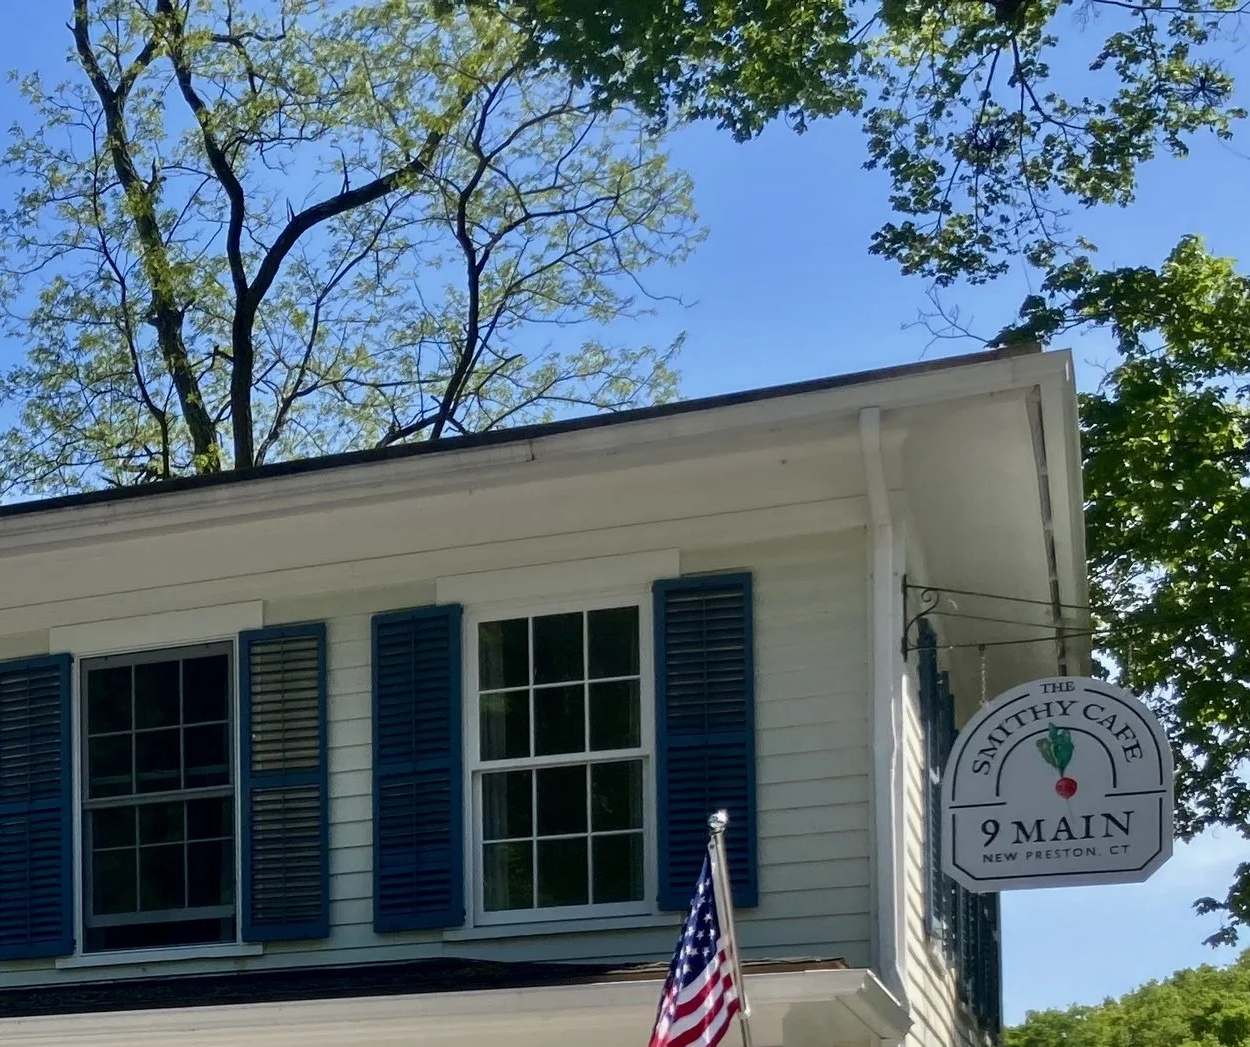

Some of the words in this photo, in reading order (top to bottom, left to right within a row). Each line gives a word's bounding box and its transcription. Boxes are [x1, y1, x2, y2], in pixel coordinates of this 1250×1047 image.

[1039, 680, 1076, 694] THE
[972, 700, 1078, 776] SMITHY
[1082, 703, 1143, 763] CAFE
[981, 818, 1000, 847] 9
[1011, 811, 1134, 845] MAIN
[983, 851, 1017, 864] NEW
[1109, 844, 1131, 855] CT
